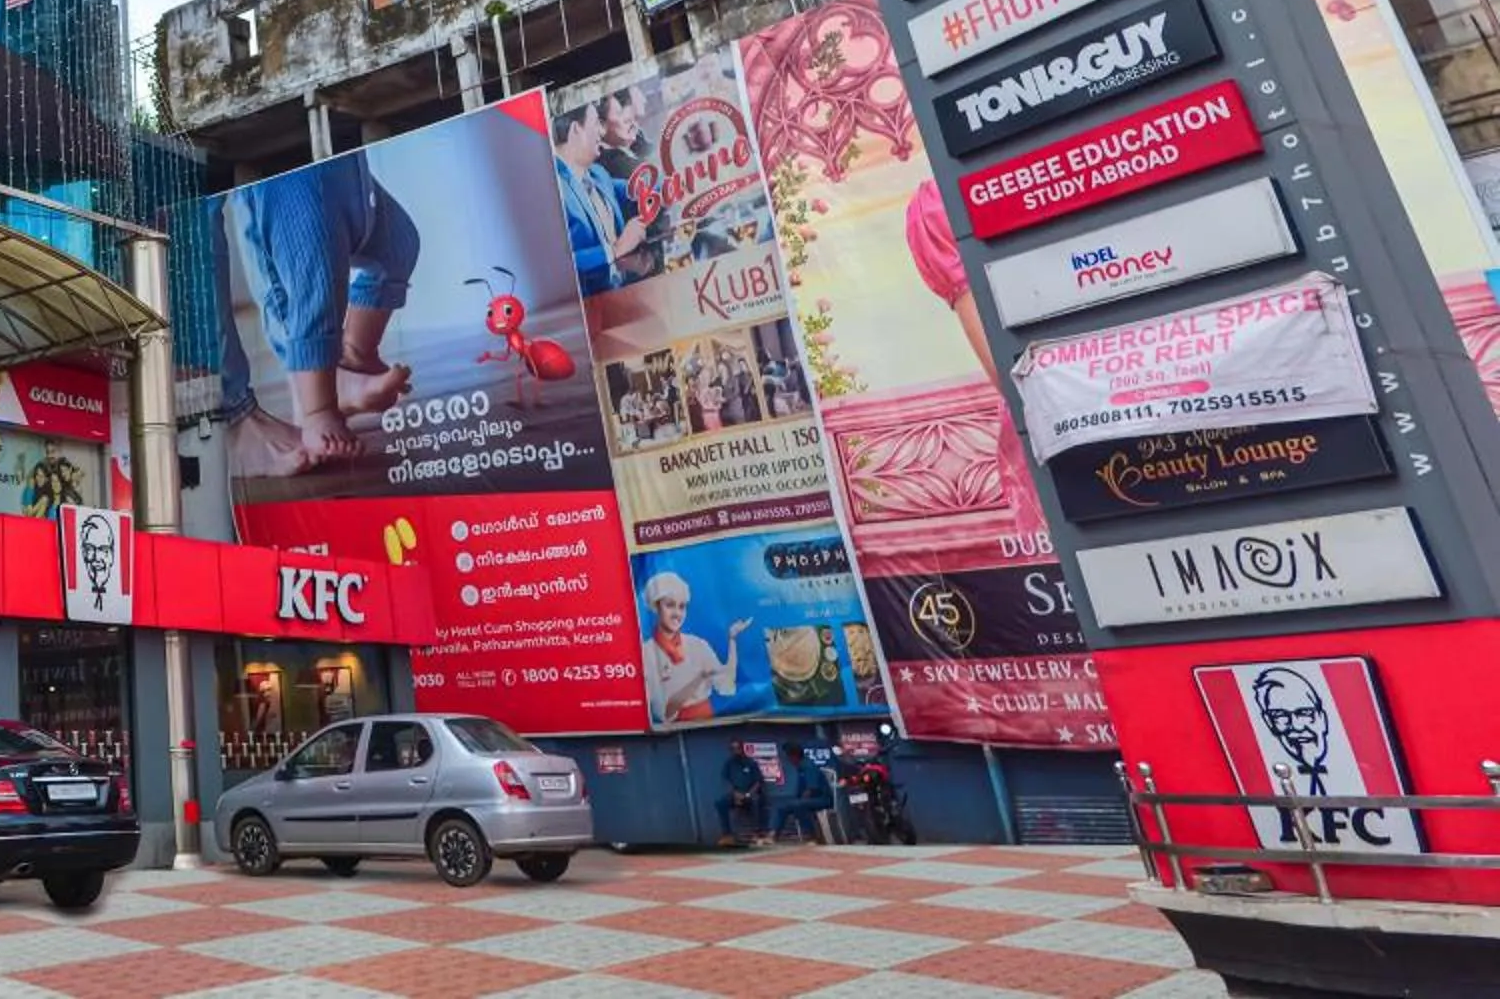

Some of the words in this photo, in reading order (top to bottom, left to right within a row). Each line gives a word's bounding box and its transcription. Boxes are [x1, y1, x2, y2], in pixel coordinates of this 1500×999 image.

[956, 12, 1168, 133] TONI&GUY
[1087, 50, 1182, 99] HAIRDRESSING
[969, 148, 1065, 207] GEEBEE
[1066, 96, 1232, 170] EDUCATION
[1022, 175, 1087, 212] STUDY
[1089, 143, 1180, 189] ABROAD
[1216, 288, 1324, 330] SPACE
[1088, 353, 1145, 379] FOR
[1155, 331, 1235, 365] RENT
[29, 386, 66, 407] GOLD
[68, 395, 103, 413] LOAN
[381, 390, 490, 433] ഓരോ
[1168, 387, 1308, 416] 7025915515
[660, 442, 725, 473] BANQUET
[729, 435, 774, 457] HALL
[1218, 433, 1319, 464] Lounge
[711, 469, 740, 484] HALL
[743, 464, 769, 478] FOR
[639, 523, 663, 538] FOR
[278, 565, 365, 624] KFC
[918, 592, 960, 626] 45
[452, 622, 482, 636] Hotel
[484, 622, 513, 635] Cum
[515, 617, 574, 636] Shopping
[577, 613, 622, 629] Arcade
[573, 631, 613, 645] Kerala
[522, 667, 559, 683] 1800
[563, 664, 601, 681] 4253
[604, 662, 637, 679] 990
[1277, 808, 1391, 846] KFC
